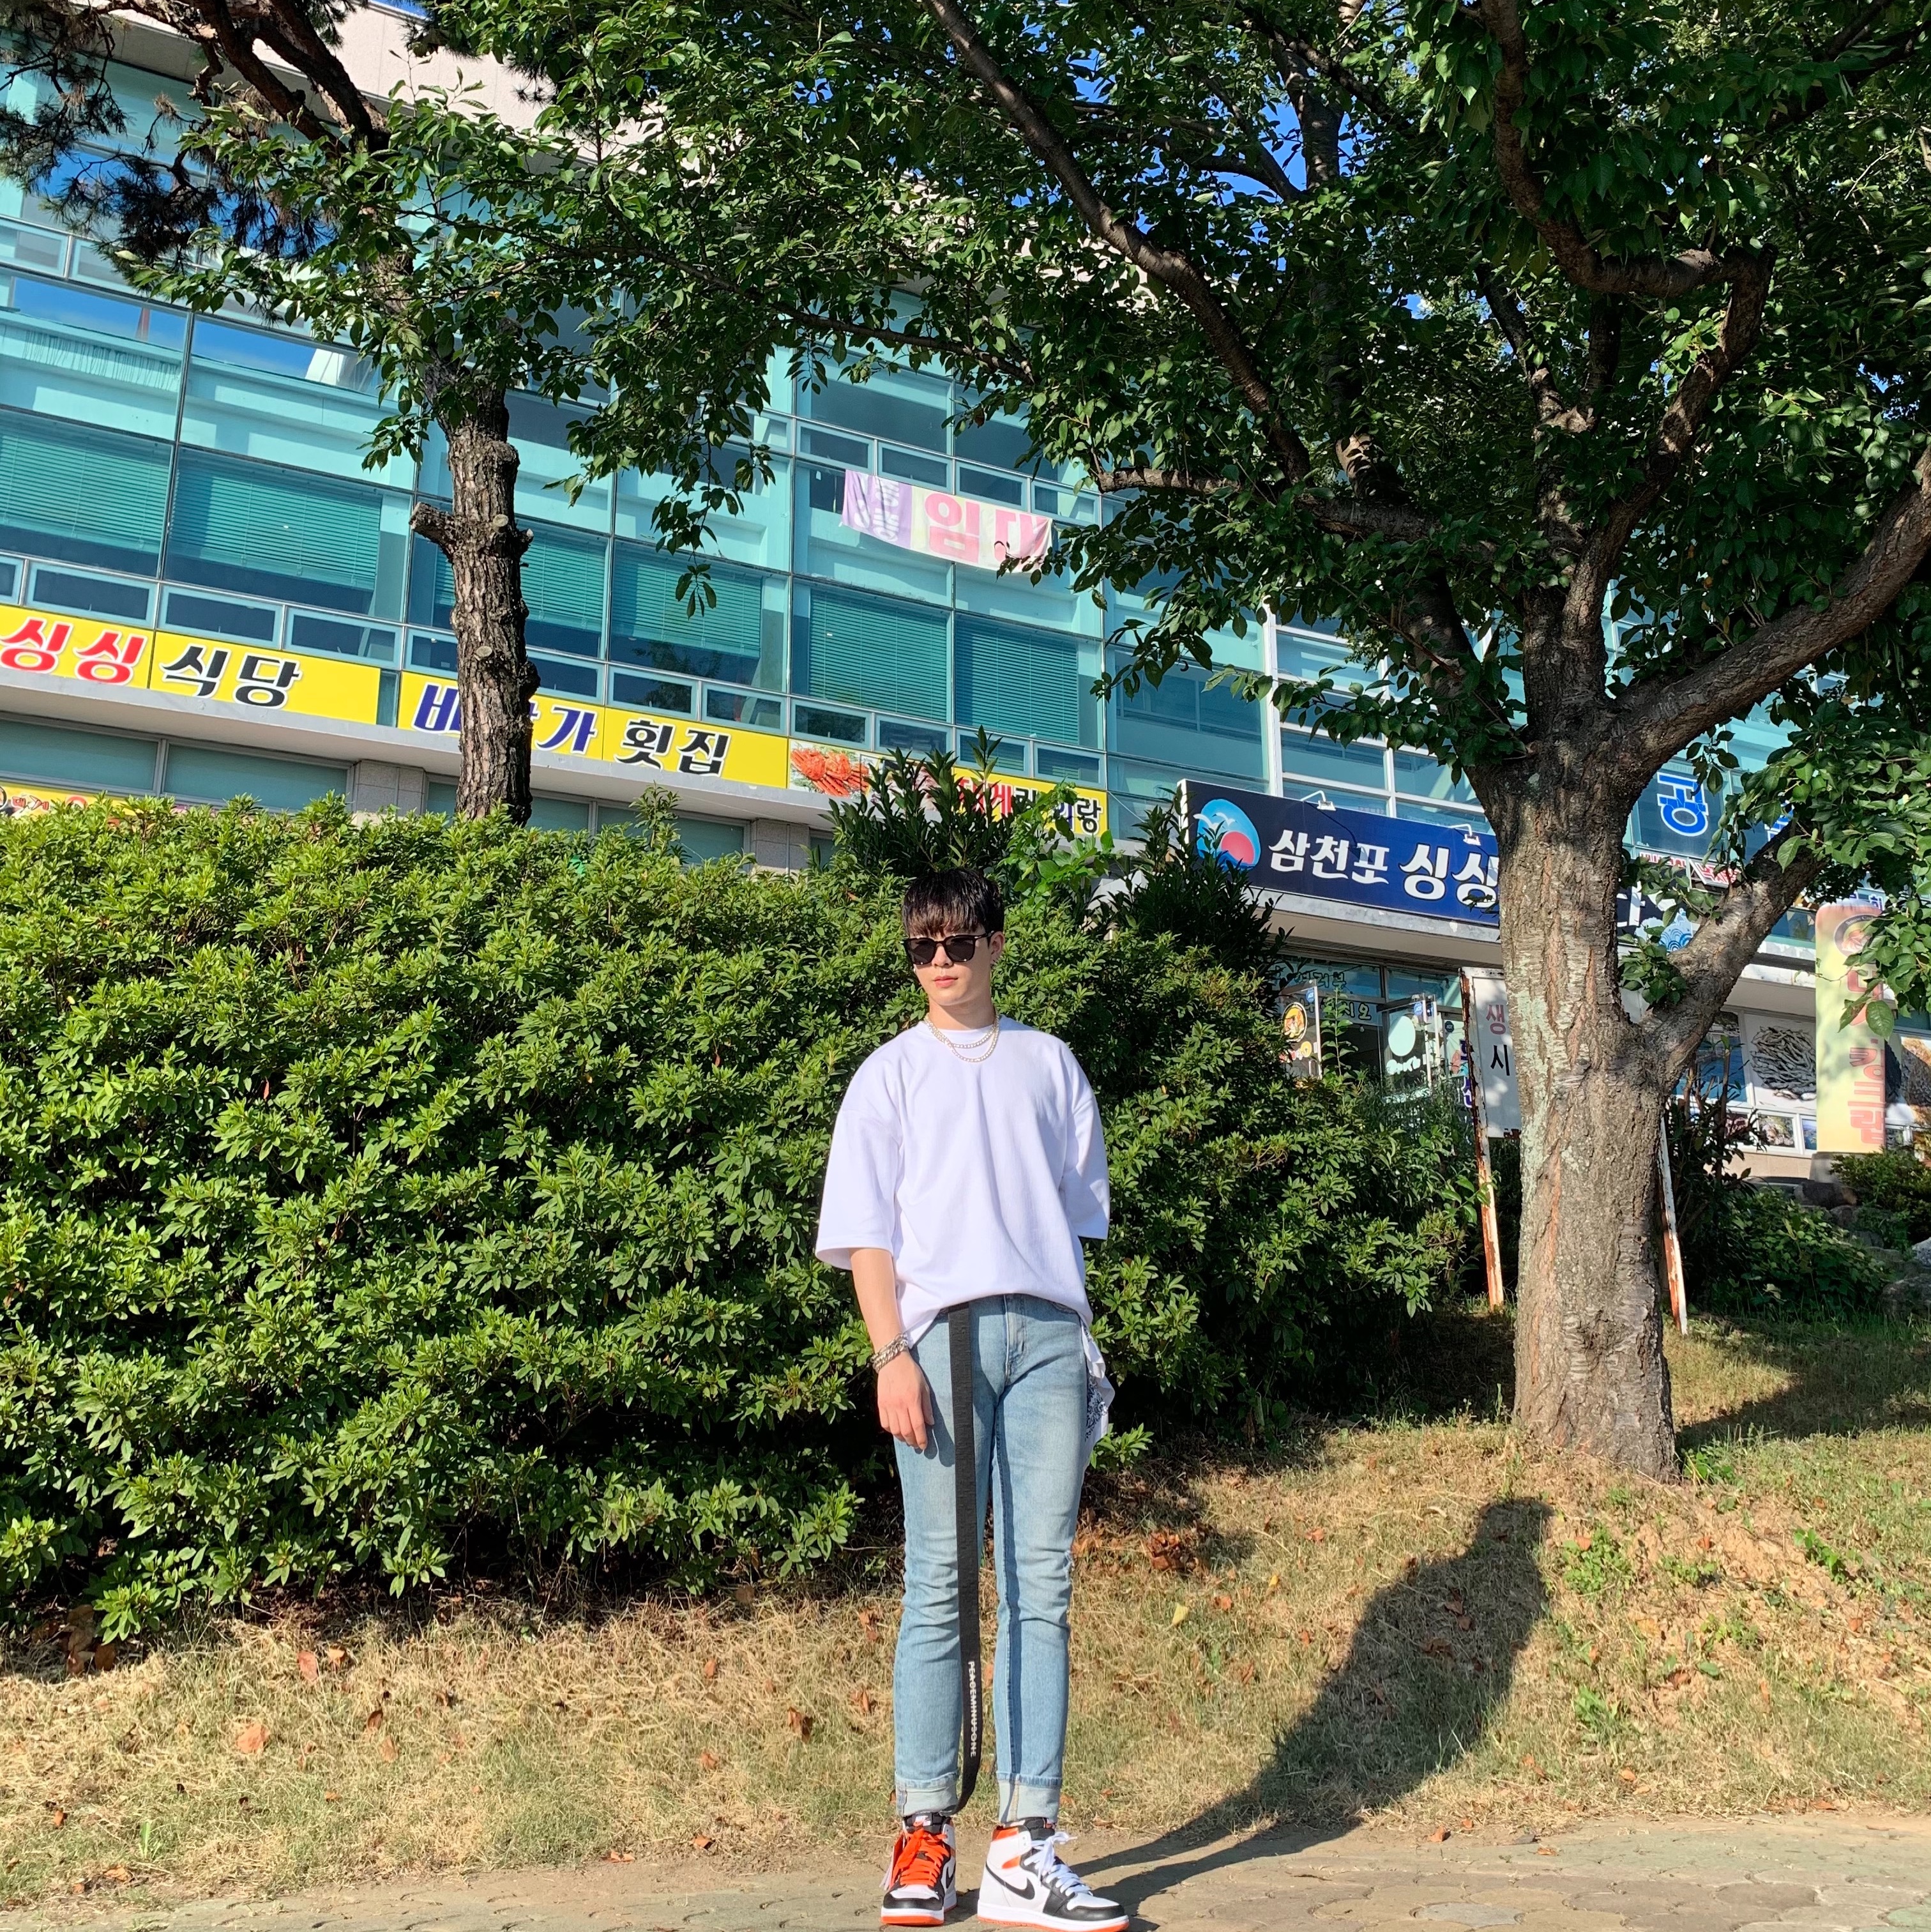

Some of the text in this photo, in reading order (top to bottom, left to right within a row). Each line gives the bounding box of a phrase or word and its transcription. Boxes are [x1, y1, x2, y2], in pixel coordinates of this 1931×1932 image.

[0, 617, 301, 708] 싱싱 식당
[615, 718, 731, 777] 횟집
[1269, 829, 1390, 885] 삼천포
[967, 1661, 978, 1758] PEACEMINUSONE
